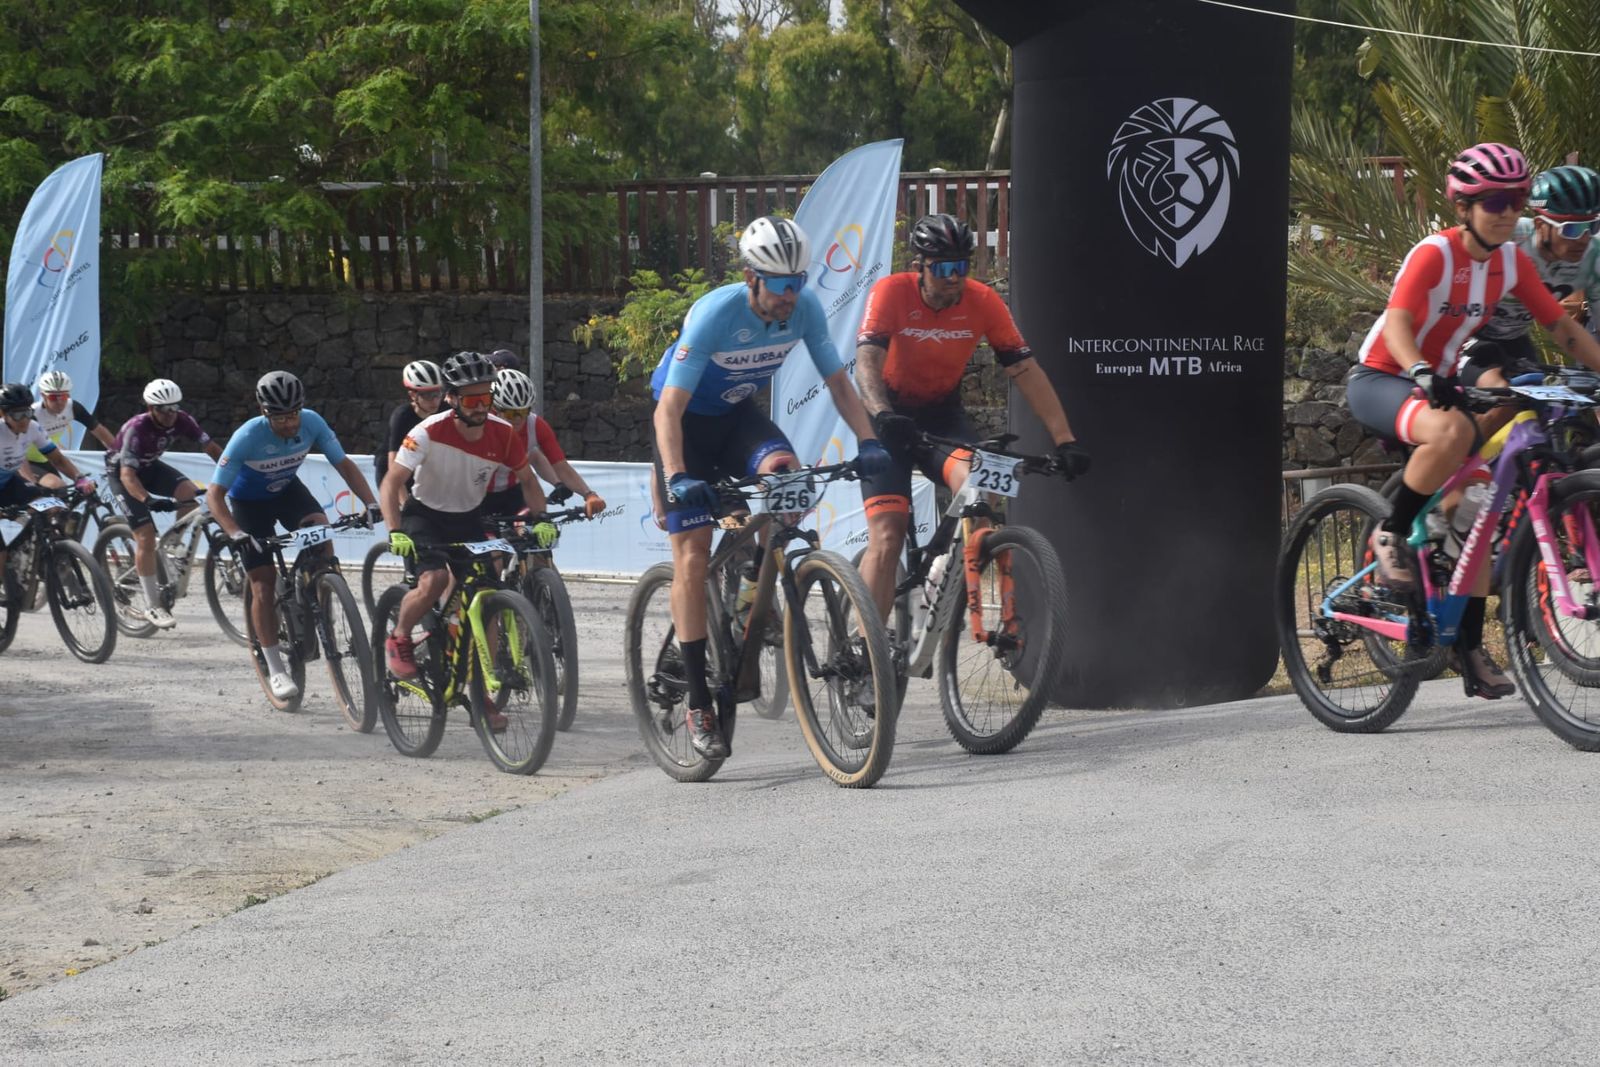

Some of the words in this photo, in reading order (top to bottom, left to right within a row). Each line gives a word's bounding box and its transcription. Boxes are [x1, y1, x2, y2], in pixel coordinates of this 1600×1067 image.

[1068, 336, 1229, 353] INTERCONTINENTAL
[1232, 335, 1265, 352] RACE
[724, 355, 750, 365] SAN
[1095, 362, 1143, 377] Europa
[1149, 356, 1203, 376] MTB
[1207, 361, 1243, 374] Africa
[787, 382, 820, 415] Ceuta
[260, 461, 278, 470] SAN
[977, 468, 1013, 493] 233
[770, 489, 810, 511] 256
[300, 528, 327, 546] 257
